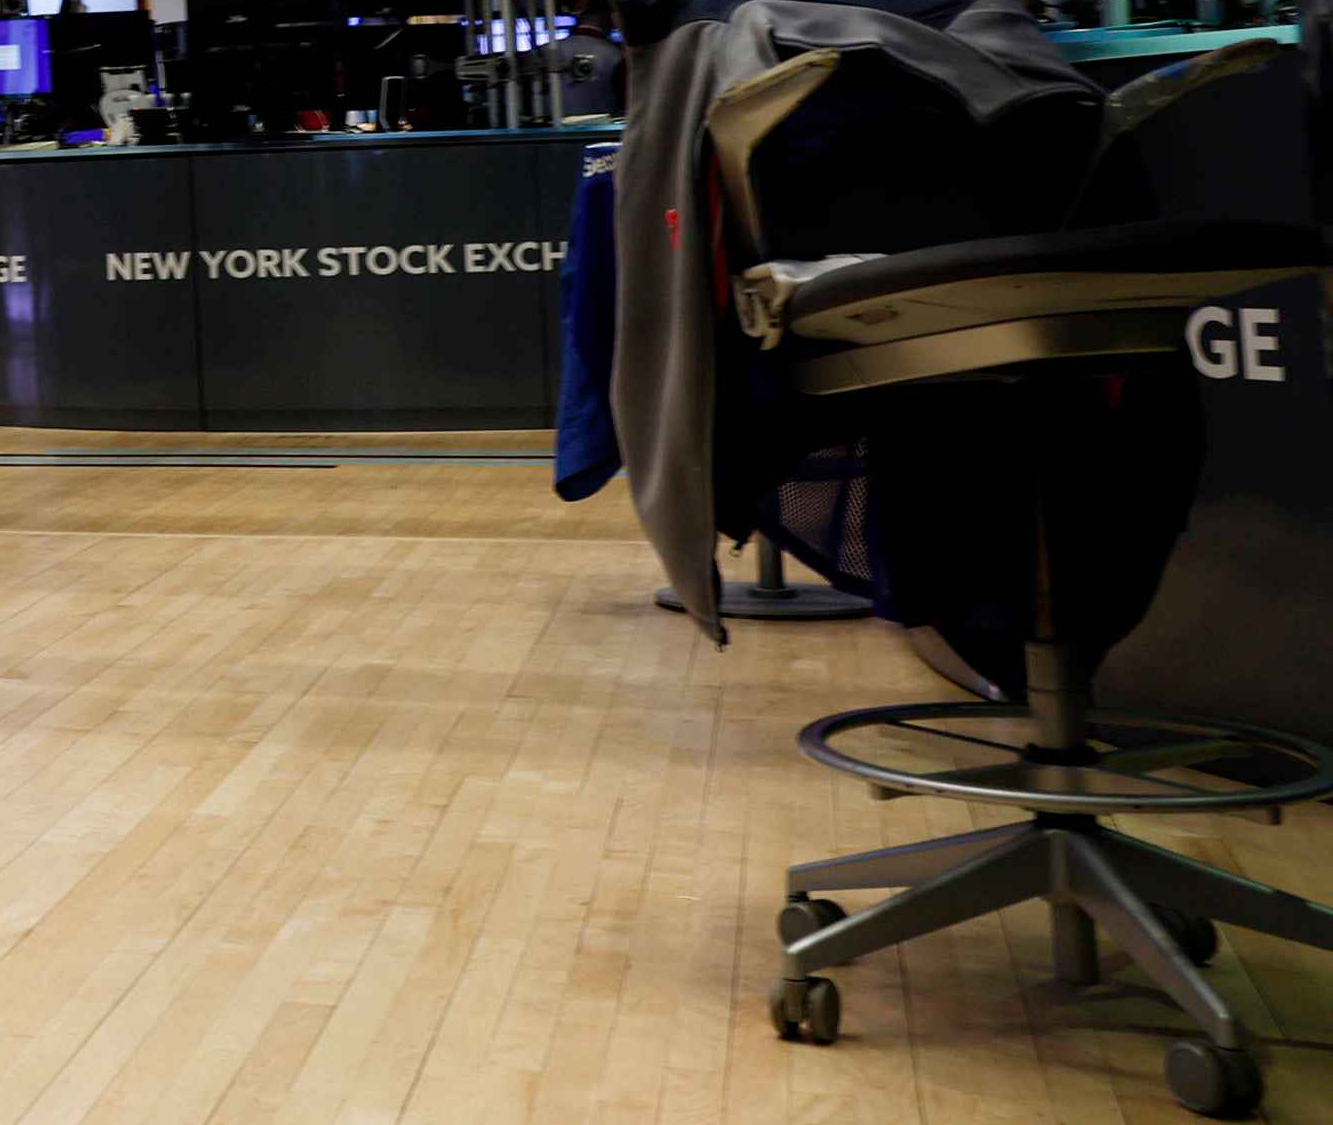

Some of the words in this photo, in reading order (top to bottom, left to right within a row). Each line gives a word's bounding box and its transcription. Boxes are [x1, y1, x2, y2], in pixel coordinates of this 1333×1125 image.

[106, 251, 190, 280] NEW
[199, 248, 309, 279] YORK
[317, 244, 455, 277] STOCK
[1185, 305, 1285, 381] GE
